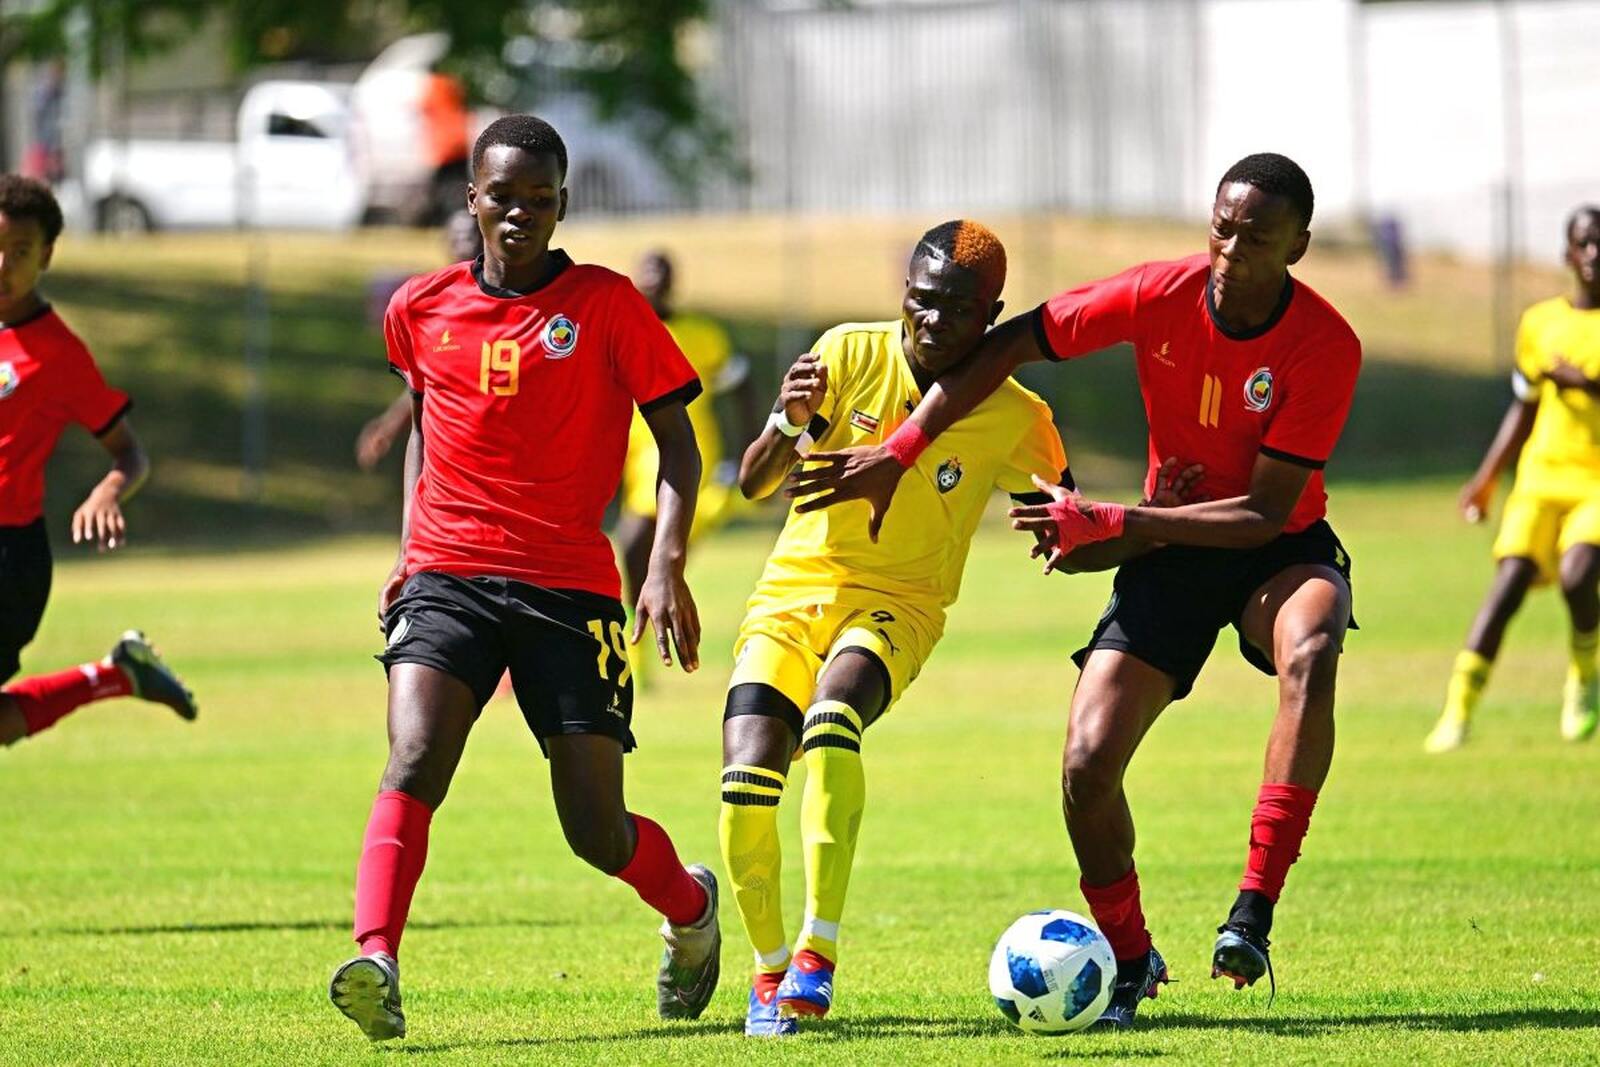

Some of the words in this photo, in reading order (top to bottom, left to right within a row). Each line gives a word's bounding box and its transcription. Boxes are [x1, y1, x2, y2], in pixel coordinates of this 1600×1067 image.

[480, 339, 520, 396] 19
[1199, 373, 1222, 428] 11
[870, 610, 895, 622] 9
[586, 618, 632, 688] 19
